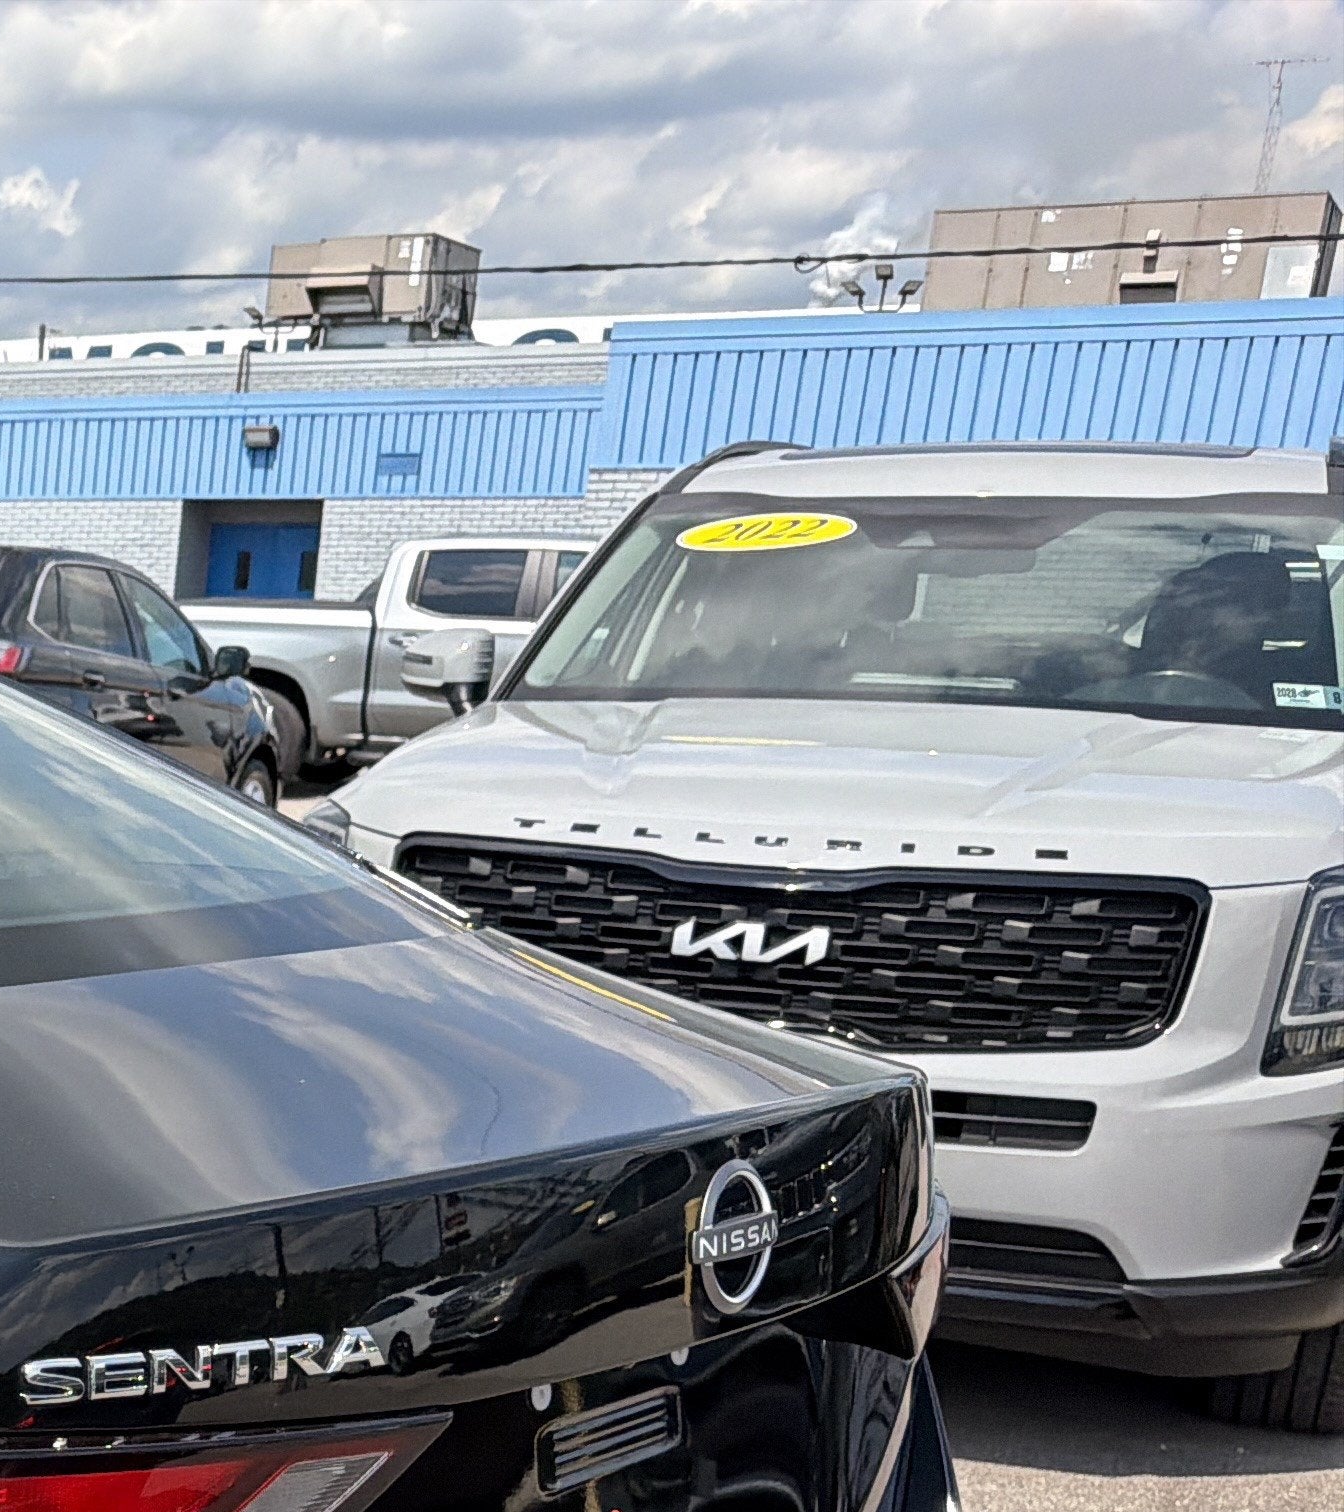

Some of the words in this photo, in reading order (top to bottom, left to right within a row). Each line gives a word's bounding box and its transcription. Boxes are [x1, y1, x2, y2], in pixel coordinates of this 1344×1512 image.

[702, 519, 829, 544] 2022
[514, 816, 1069, 861] TELLURIDE
[671, 917, 830, 965] KIA
[698, 1218, 778, 1260] NISSAN
[19, 1326, 387, 1405] SENTRA
